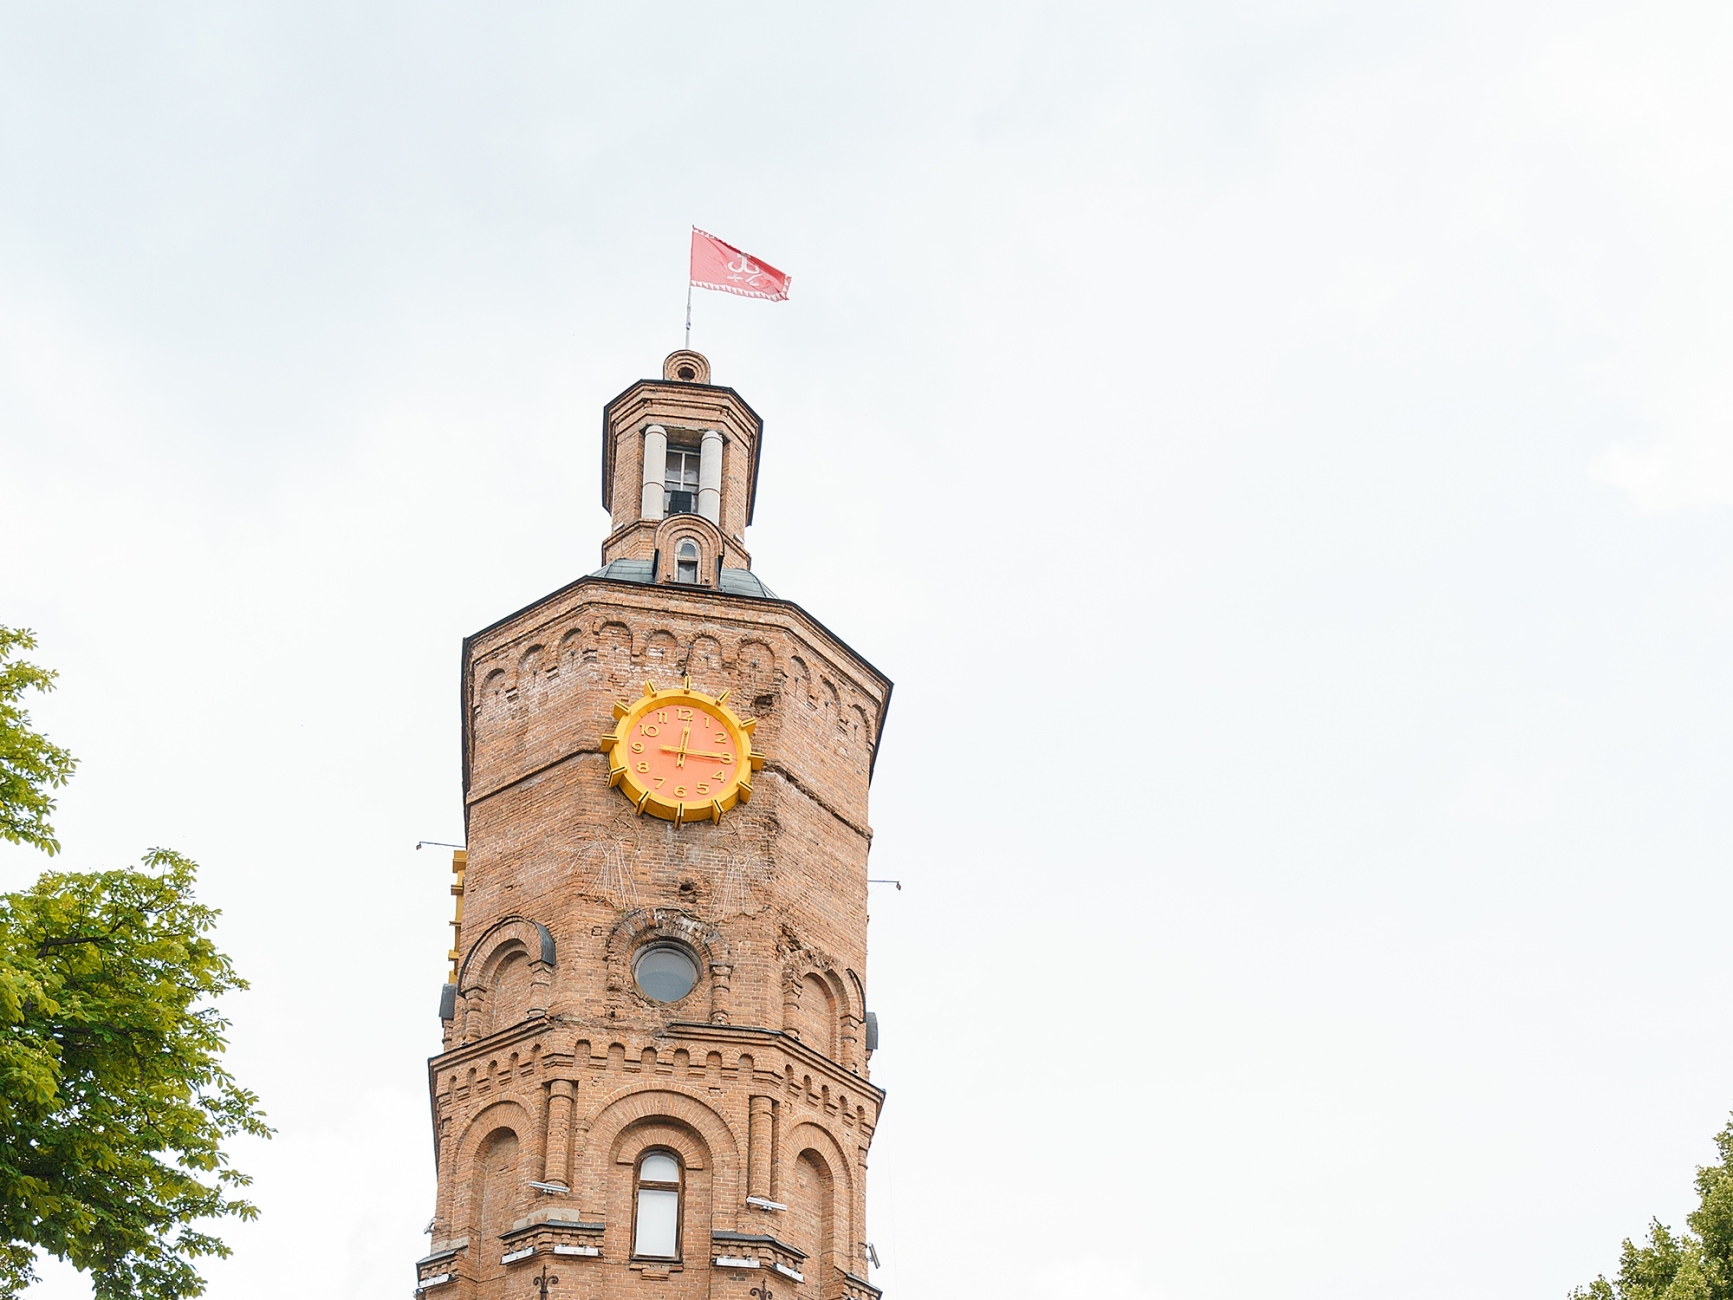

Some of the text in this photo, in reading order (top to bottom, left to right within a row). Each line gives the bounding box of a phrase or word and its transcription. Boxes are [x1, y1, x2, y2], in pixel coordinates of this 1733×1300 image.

[657, 711, 668, 724] 11
[676, 708, 693, 721] 12
[704, 717, 711, 728] 1
[640, 724, 660, 737] 10
[714, 732, 727, 744] 2
[631, 742, 645, 754] 9
[720, 752, 733, 764] 3
[636, 761, 650, 773] 8
[653, 776, 666, 789] 7
[711, 770, 726, 783] 4
[674, 786, 687, 798] 6
[697, 782, 710, 795] 5
